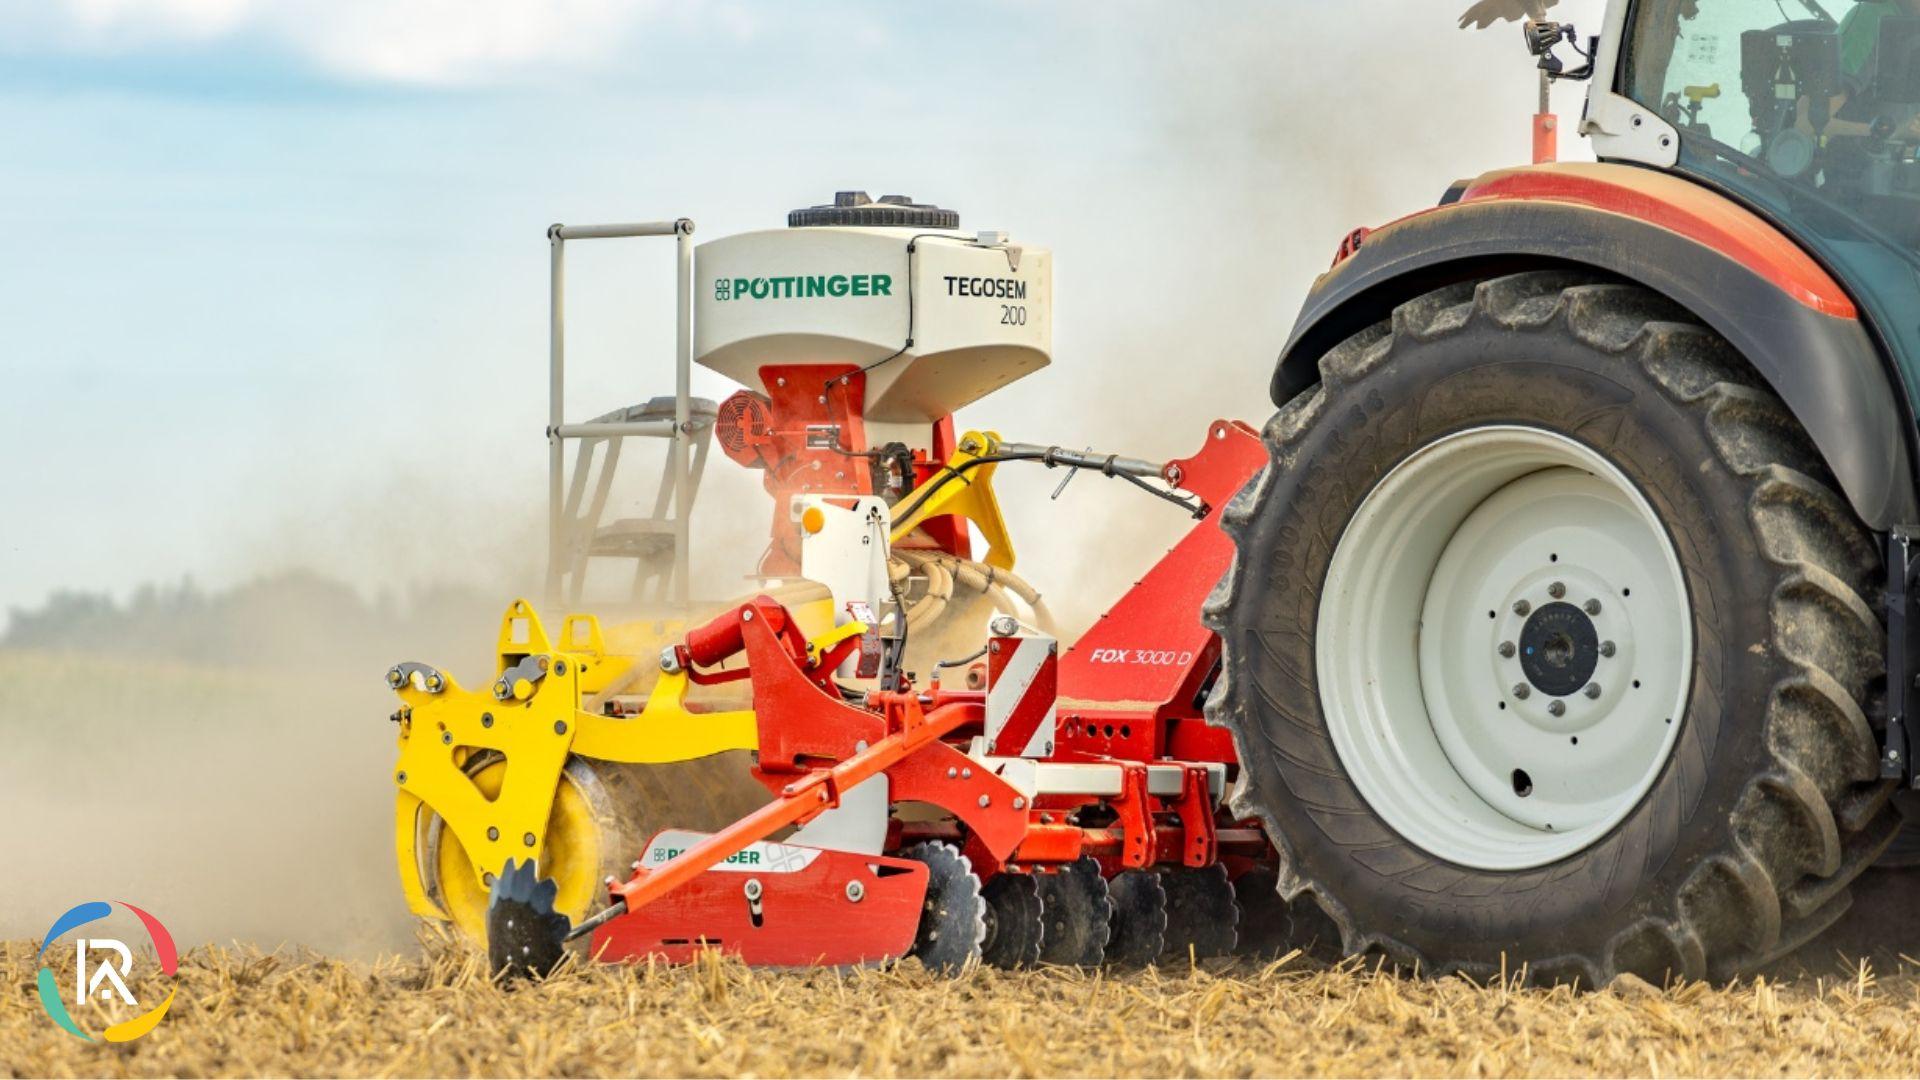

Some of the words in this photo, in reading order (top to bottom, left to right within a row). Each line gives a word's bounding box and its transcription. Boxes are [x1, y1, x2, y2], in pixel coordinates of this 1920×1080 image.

[733, 274, 892, 300] PÖTTINGER
[943, 276, 1027, 300] TEGOSEM
[1000, 304, 1027, 326] 200
[1089, 648, 1130, 663] FOX
[1130, 649, 1176, 665] 3000
[1177, 651, 1192, 666] D
